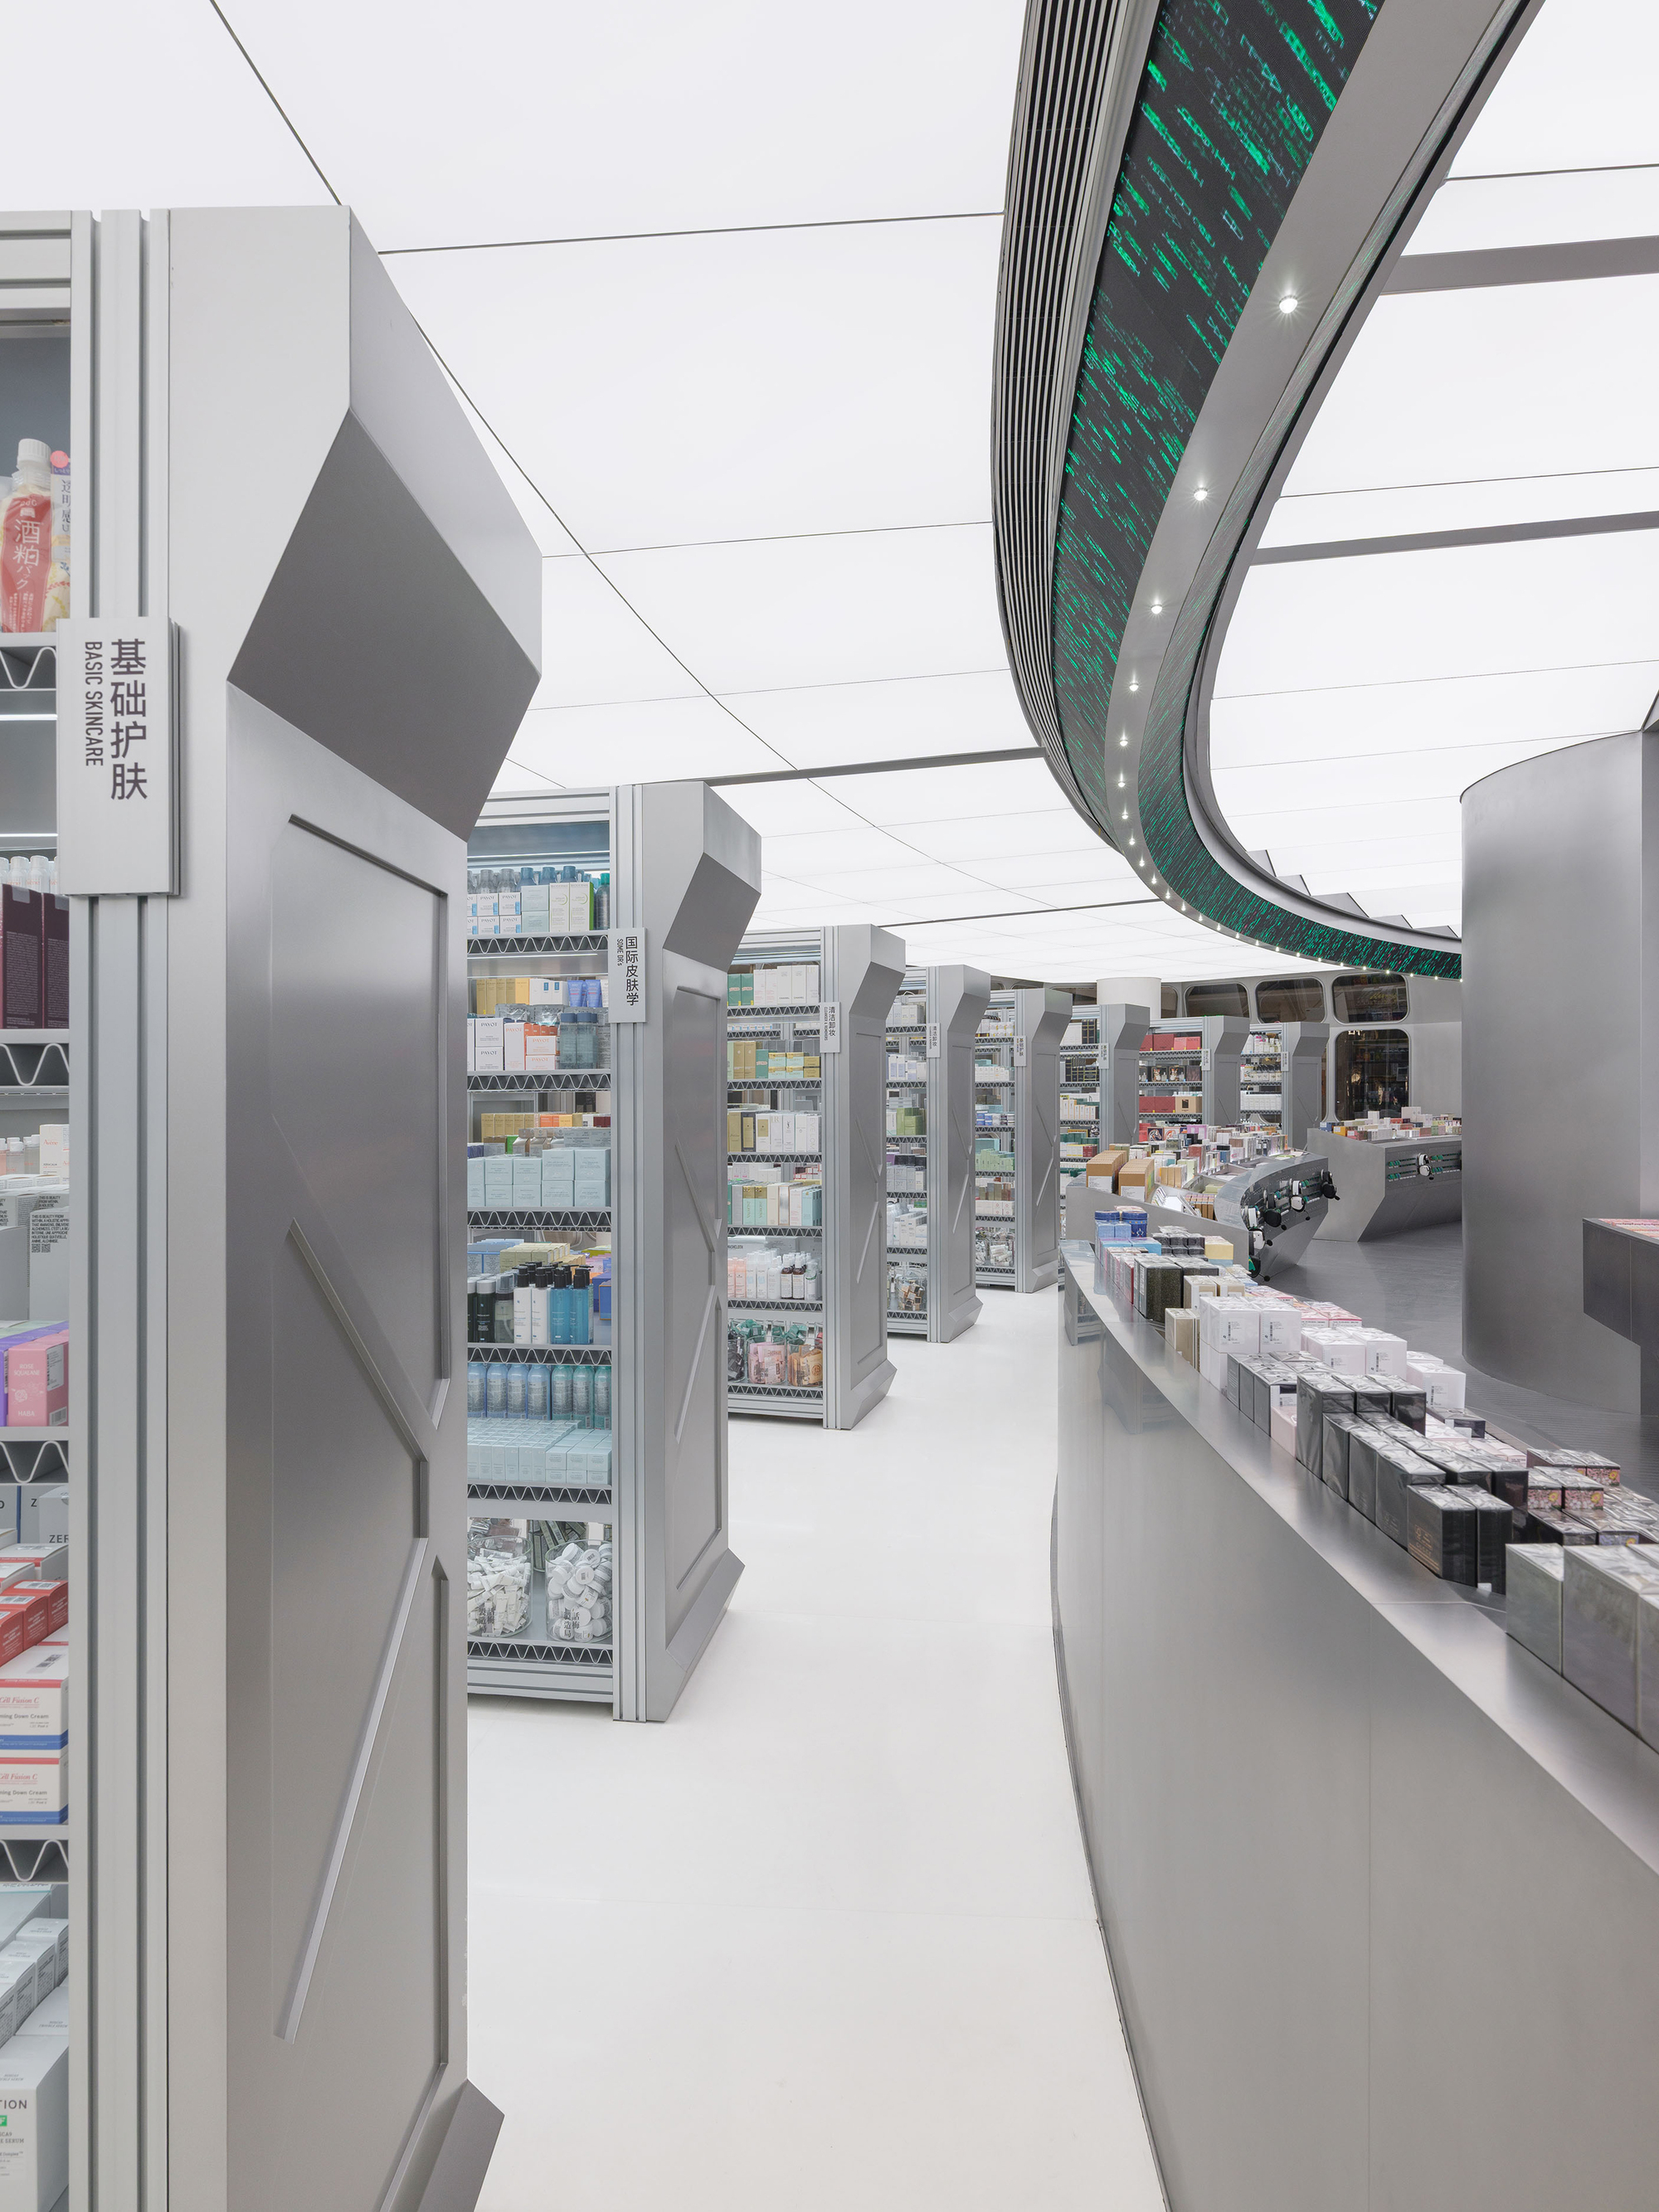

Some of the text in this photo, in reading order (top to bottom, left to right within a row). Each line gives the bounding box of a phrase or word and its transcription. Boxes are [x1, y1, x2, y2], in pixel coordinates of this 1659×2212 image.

[85, 642, 104, 766] BASIC SKINCARE
[110, 638, 148, 800] 基础护肤
[625, 936, 639, 1006] 国际皮肤学
